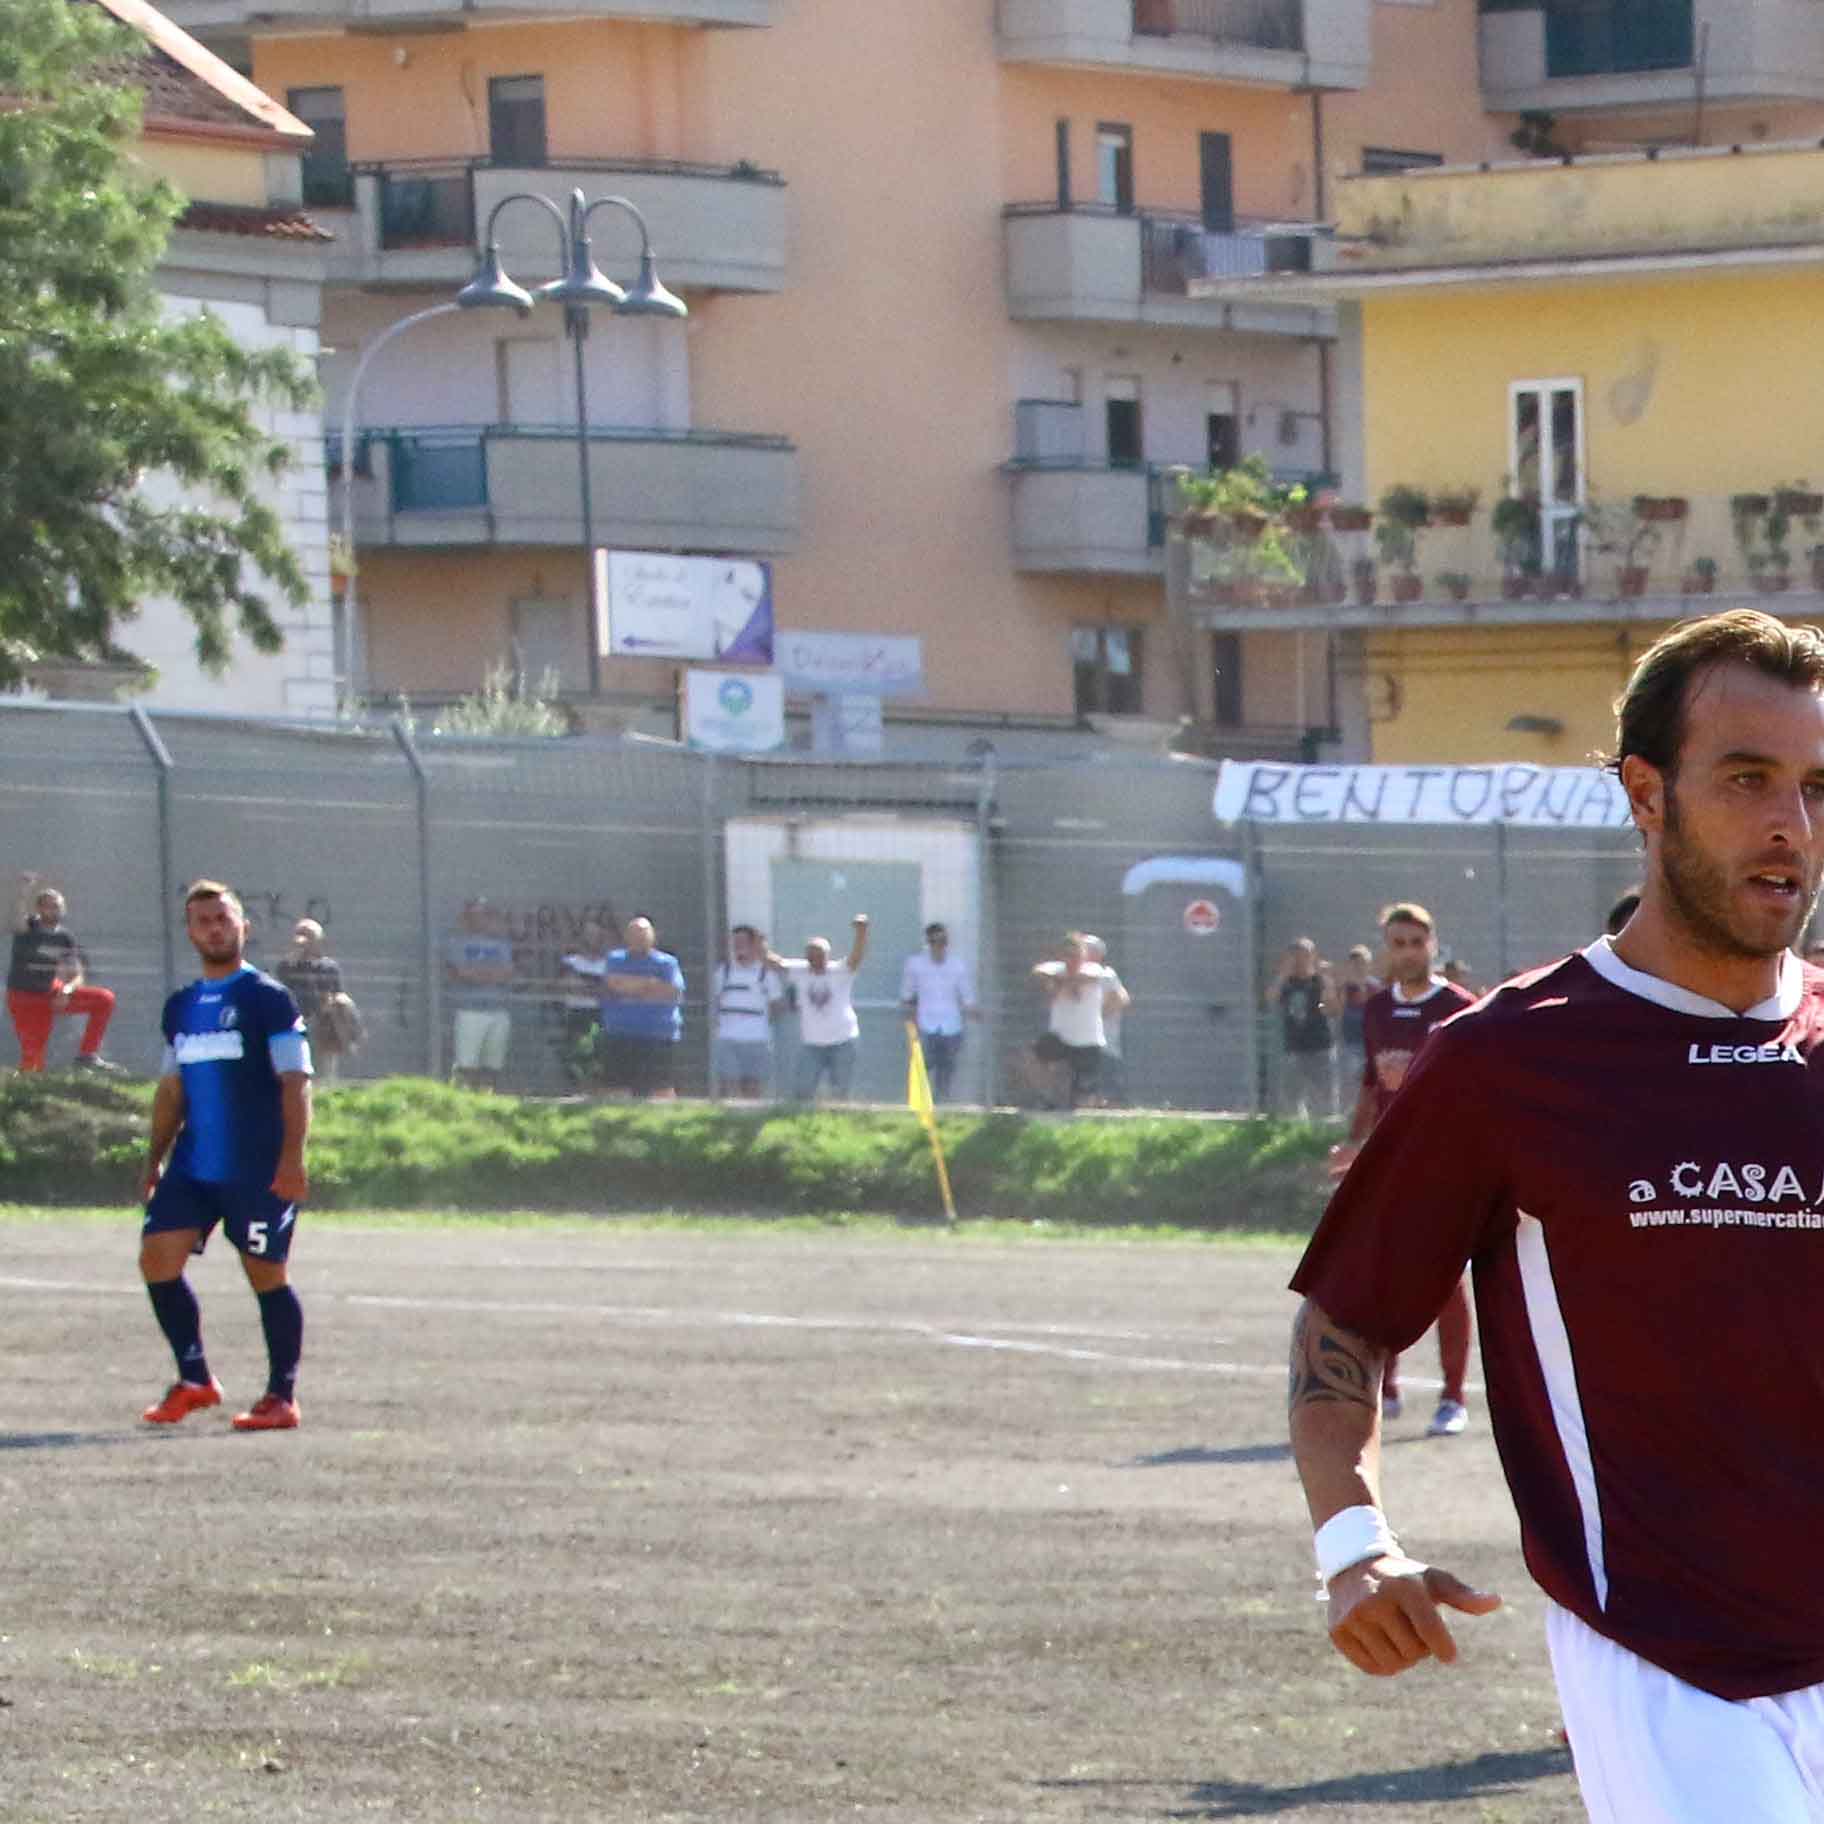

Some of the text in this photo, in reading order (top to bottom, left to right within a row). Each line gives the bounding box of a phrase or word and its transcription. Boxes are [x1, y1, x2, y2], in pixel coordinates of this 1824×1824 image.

[1240, 765, 1632, 825] BENTORNA
[1688, 1043, 1807, 1065] LEGEA
[1629, 1179, 1657, 1203] a
[1669, 1160, 1807, 1203] CASA
[248, 1221, 268, 1255] 5
